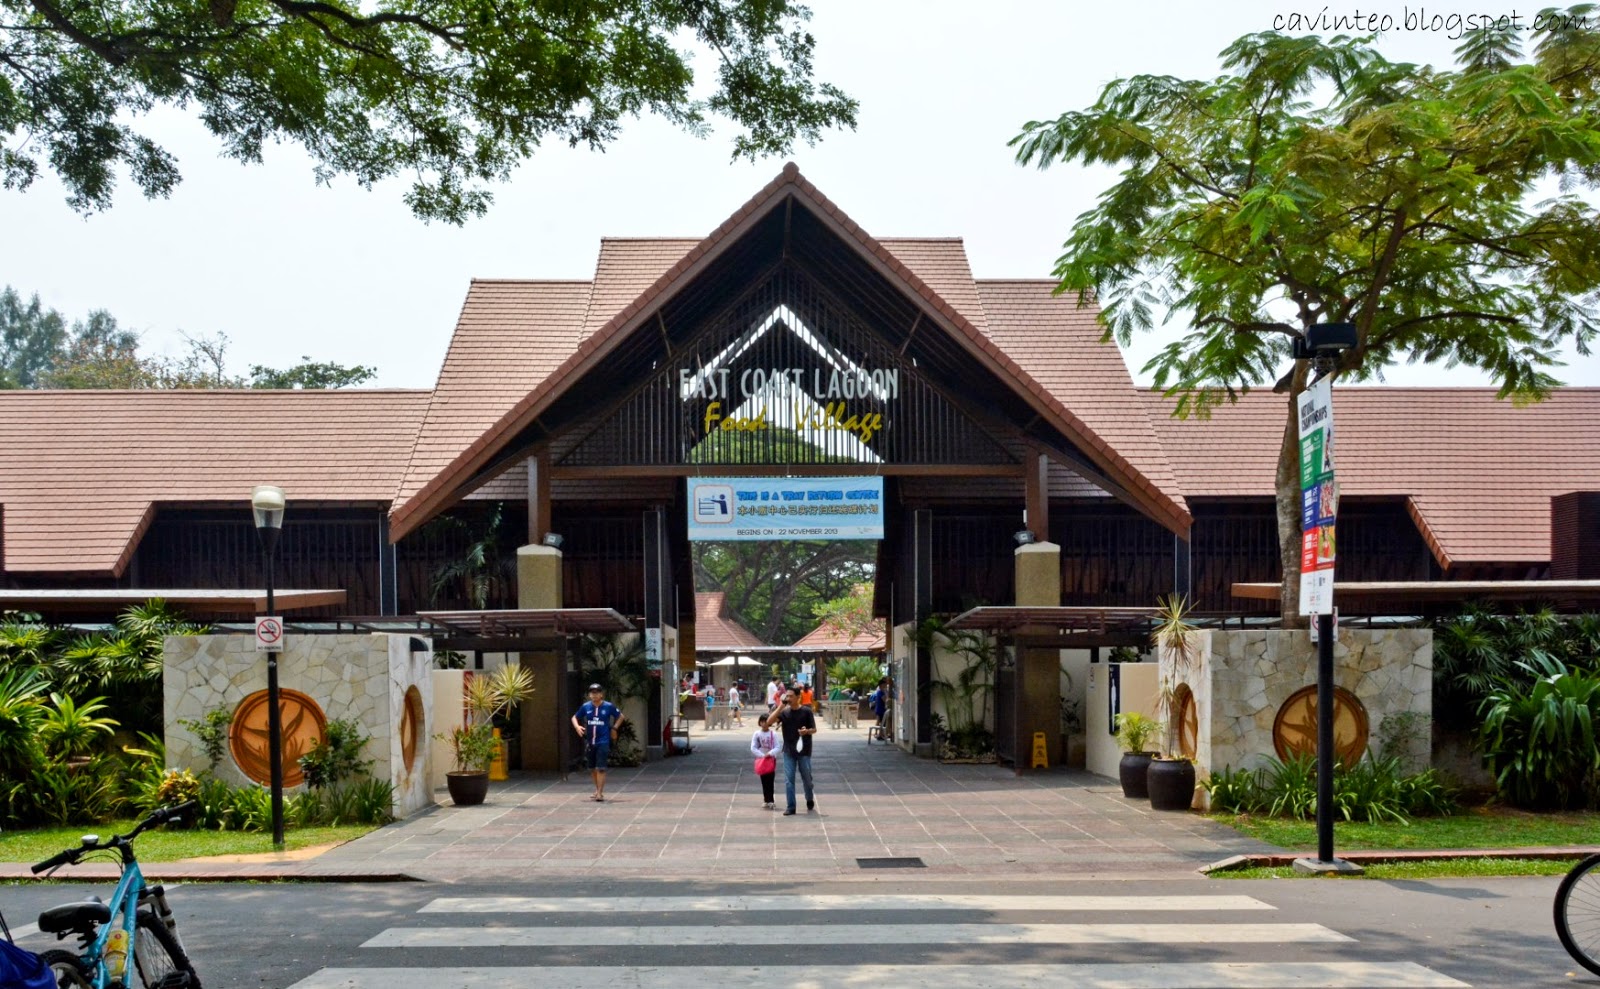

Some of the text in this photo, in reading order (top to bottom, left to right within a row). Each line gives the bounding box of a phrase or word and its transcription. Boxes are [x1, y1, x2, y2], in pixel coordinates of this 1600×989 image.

[679, 368, 898, 399] EAST COAST LAGOON
[704, 401, 882, 443] Food Village
[736, 490, 879, 501] THIS IS A TRAY RETURN CENTRE
[737, 528, 761, 536] BEGINS
[762, 528, 773, 536] ON
[779, 528, 787, 536] 22
[788, 528, 823, 536] NOVEMBER
